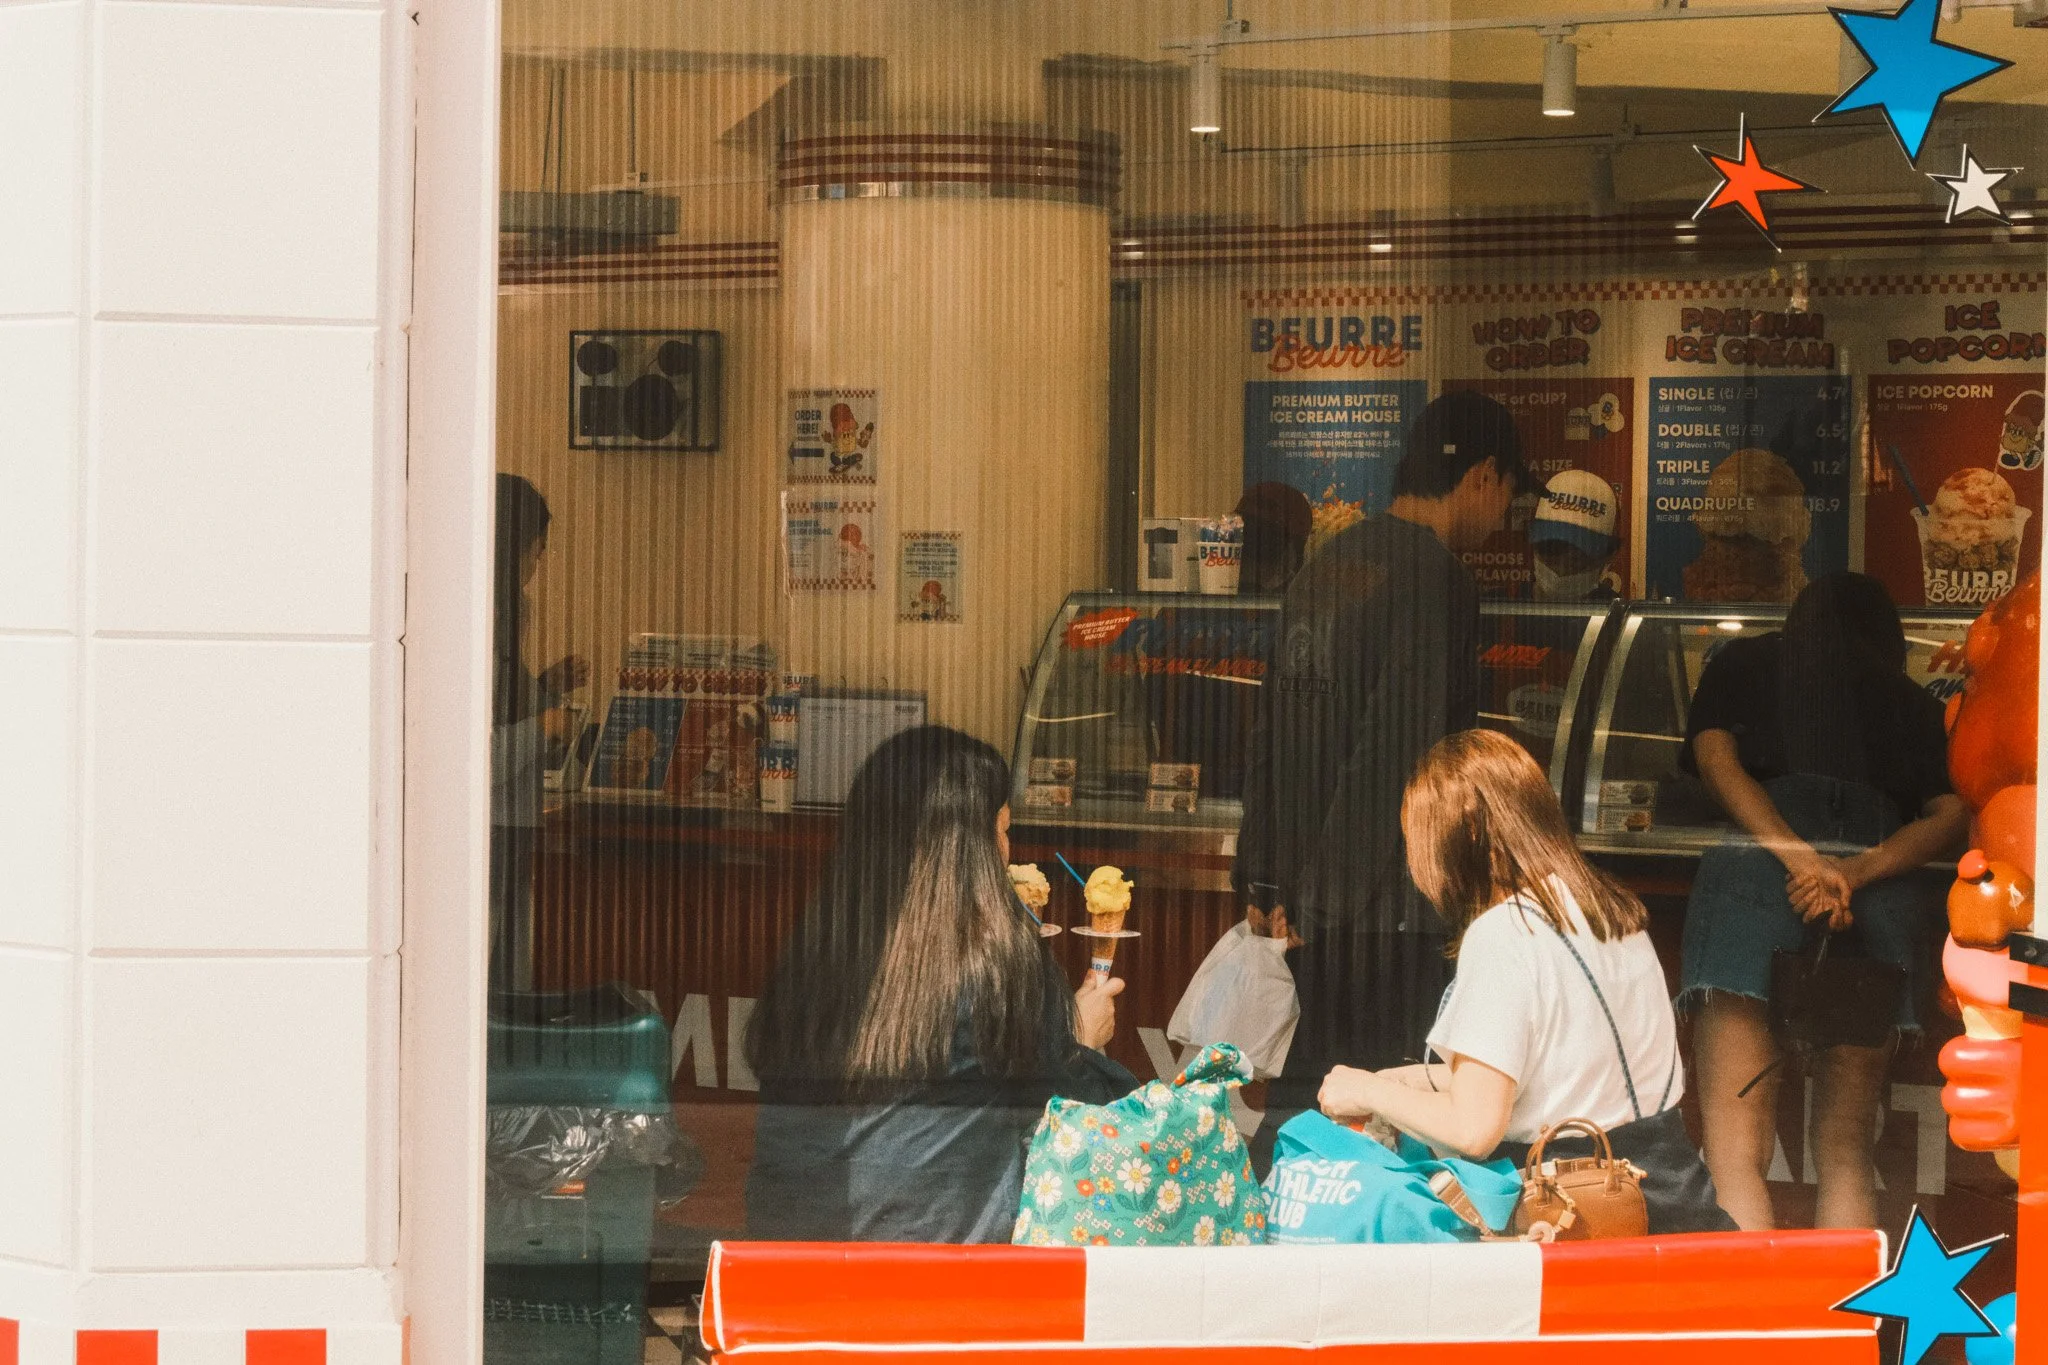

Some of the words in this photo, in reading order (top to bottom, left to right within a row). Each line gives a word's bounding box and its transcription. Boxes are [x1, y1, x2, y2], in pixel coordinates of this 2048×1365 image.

[1555, 308, 1601, 336] TO
[1680, 306, 1825, 341] PREMIUM
[1944, 300, 2001, 332] ICE
[1251, 315, 1423, 355] BEURRE
[1268, 333, 1412, 374] Beurre
[1485, 338, 1591, 372] ORDER
[1665, 336, 1718, 363] ICE
[1721, 337, 1835, 368] CREAM
[1510, 394, 1525, 405] or
[1529, 391, 1568, 406] CUP?
[1658, 386, 1716, 401] SINGLE
[1877, 385, 1905, 399] ICE
[1908, 384, 1994, 399] POPCORN
[1272, 394, 1342, 408] PREMIUM
[1343, 394, 1399, 408] BUTTER
[795, 409, 822, 421] ORDER
[1270, 411, 1294, 424] ICE
[1296, 410, 1349, 424] CREAM
[1351, 410, 1401, 424] HOUSE
[1658, 423, 1722, 438] DOUBLE
[1542, 460, 1573, 472] SIZE
[1656, 459, 1710, 474] TRIPLE
[1812, 460, 1841, 475] 11.2
[1656, 496, 1756, 513] QUADRUPLE
[1807, 497, 1841, 512] 18.9
[1461, 552, 1524, 566] CHOOSE
[1261, 1165, 1362, 1205] ATHLETIC
